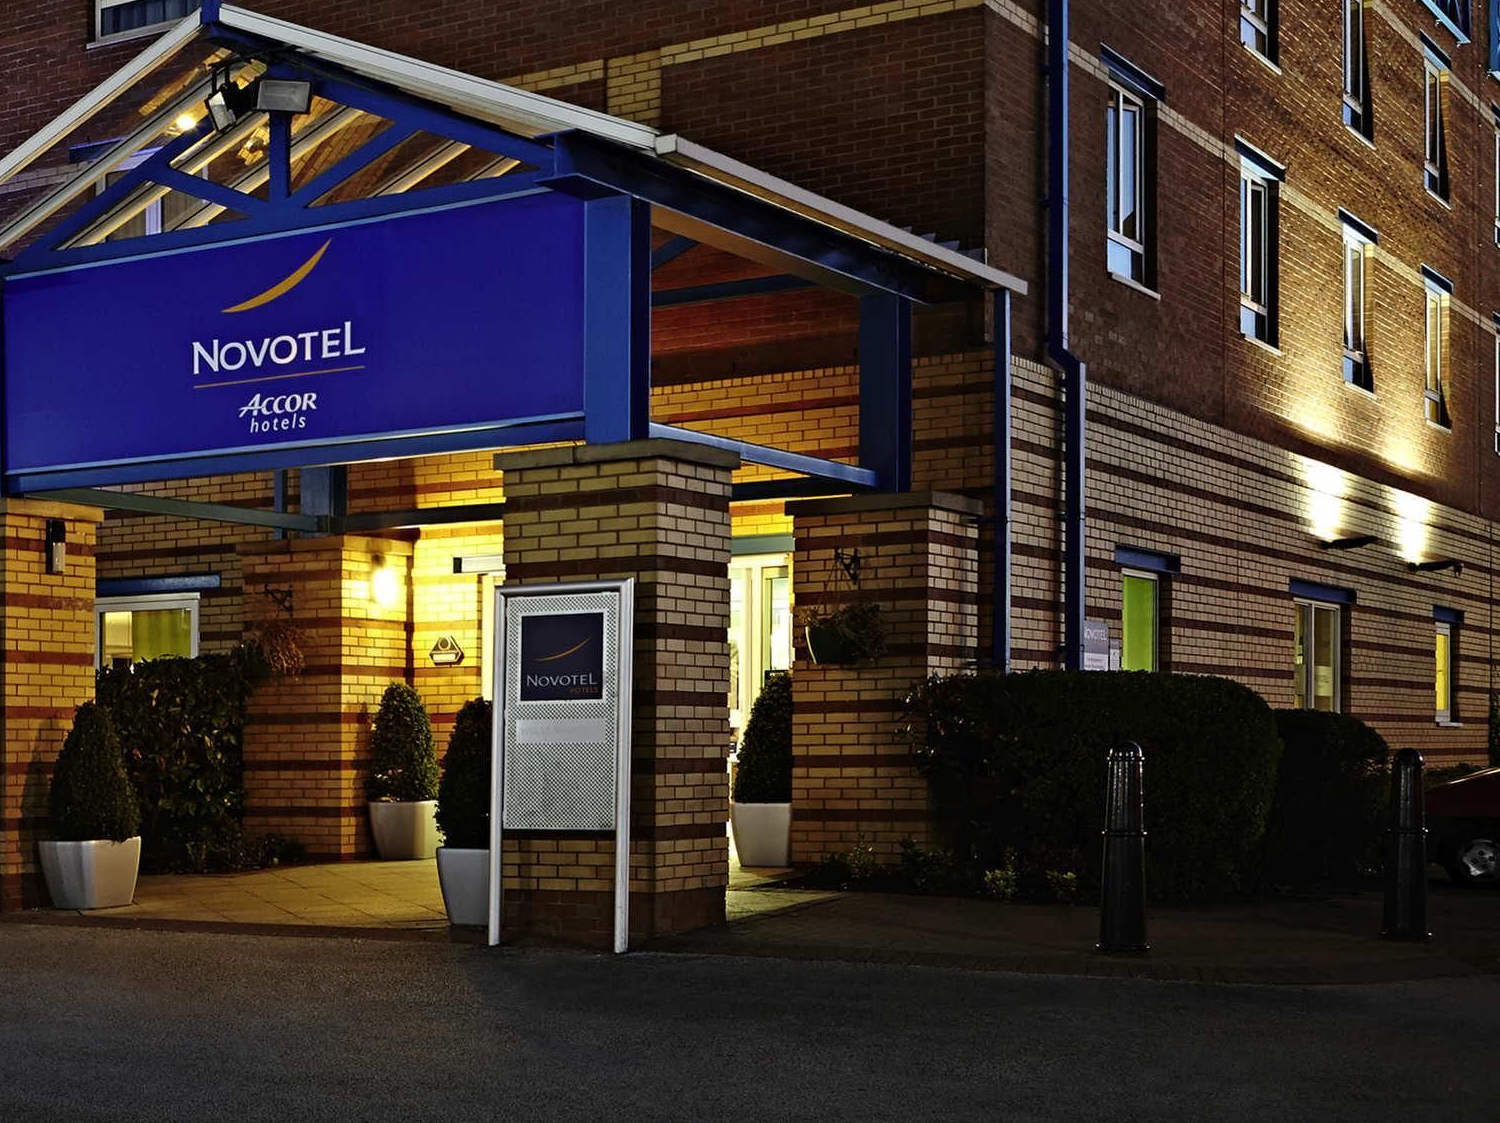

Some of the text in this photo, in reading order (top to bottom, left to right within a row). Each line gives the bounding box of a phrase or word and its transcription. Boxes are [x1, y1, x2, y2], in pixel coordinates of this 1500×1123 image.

[192, 321, 366, 375] NOVOTEL
[250, 413, 306, 433] hotels
[526, 672, 598, 687] NOVOTEL
